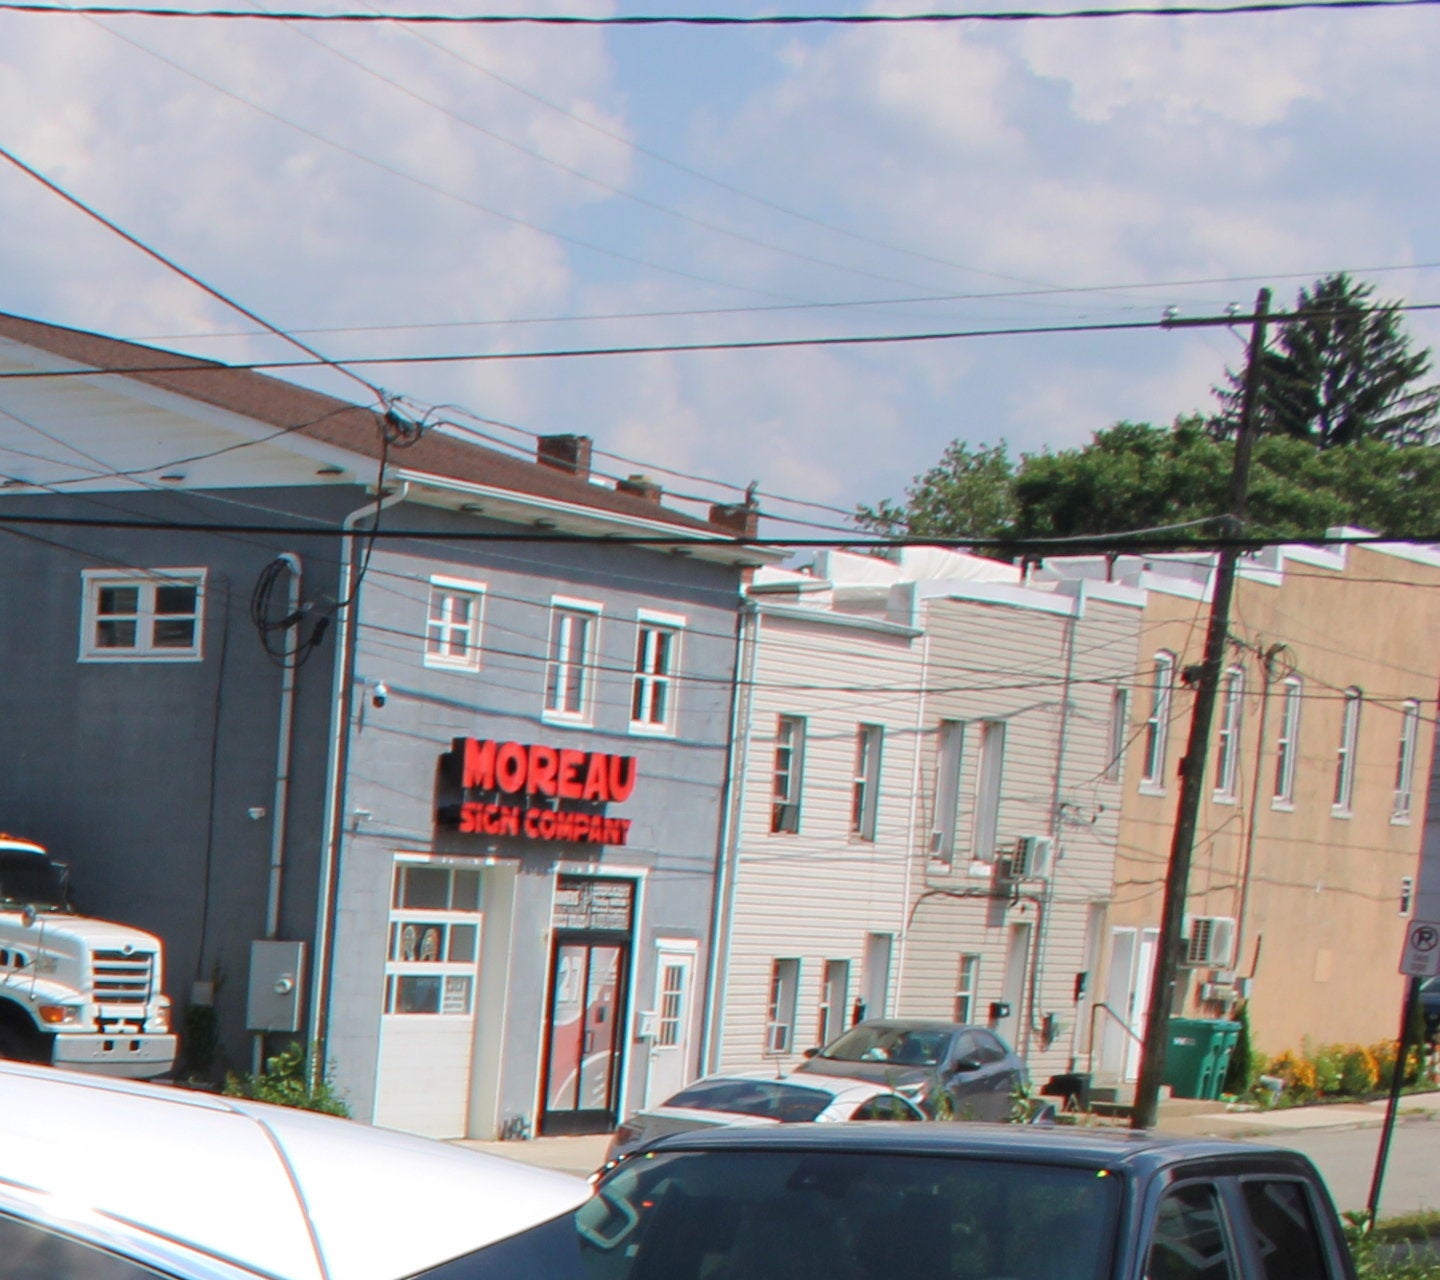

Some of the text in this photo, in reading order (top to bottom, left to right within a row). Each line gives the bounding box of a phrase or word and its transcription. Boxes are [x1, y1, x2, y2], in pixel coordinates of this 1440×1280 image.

[462, 737, 637, 803] MOREAU
[460, 802, 633, 846] SIGN COMPANY
